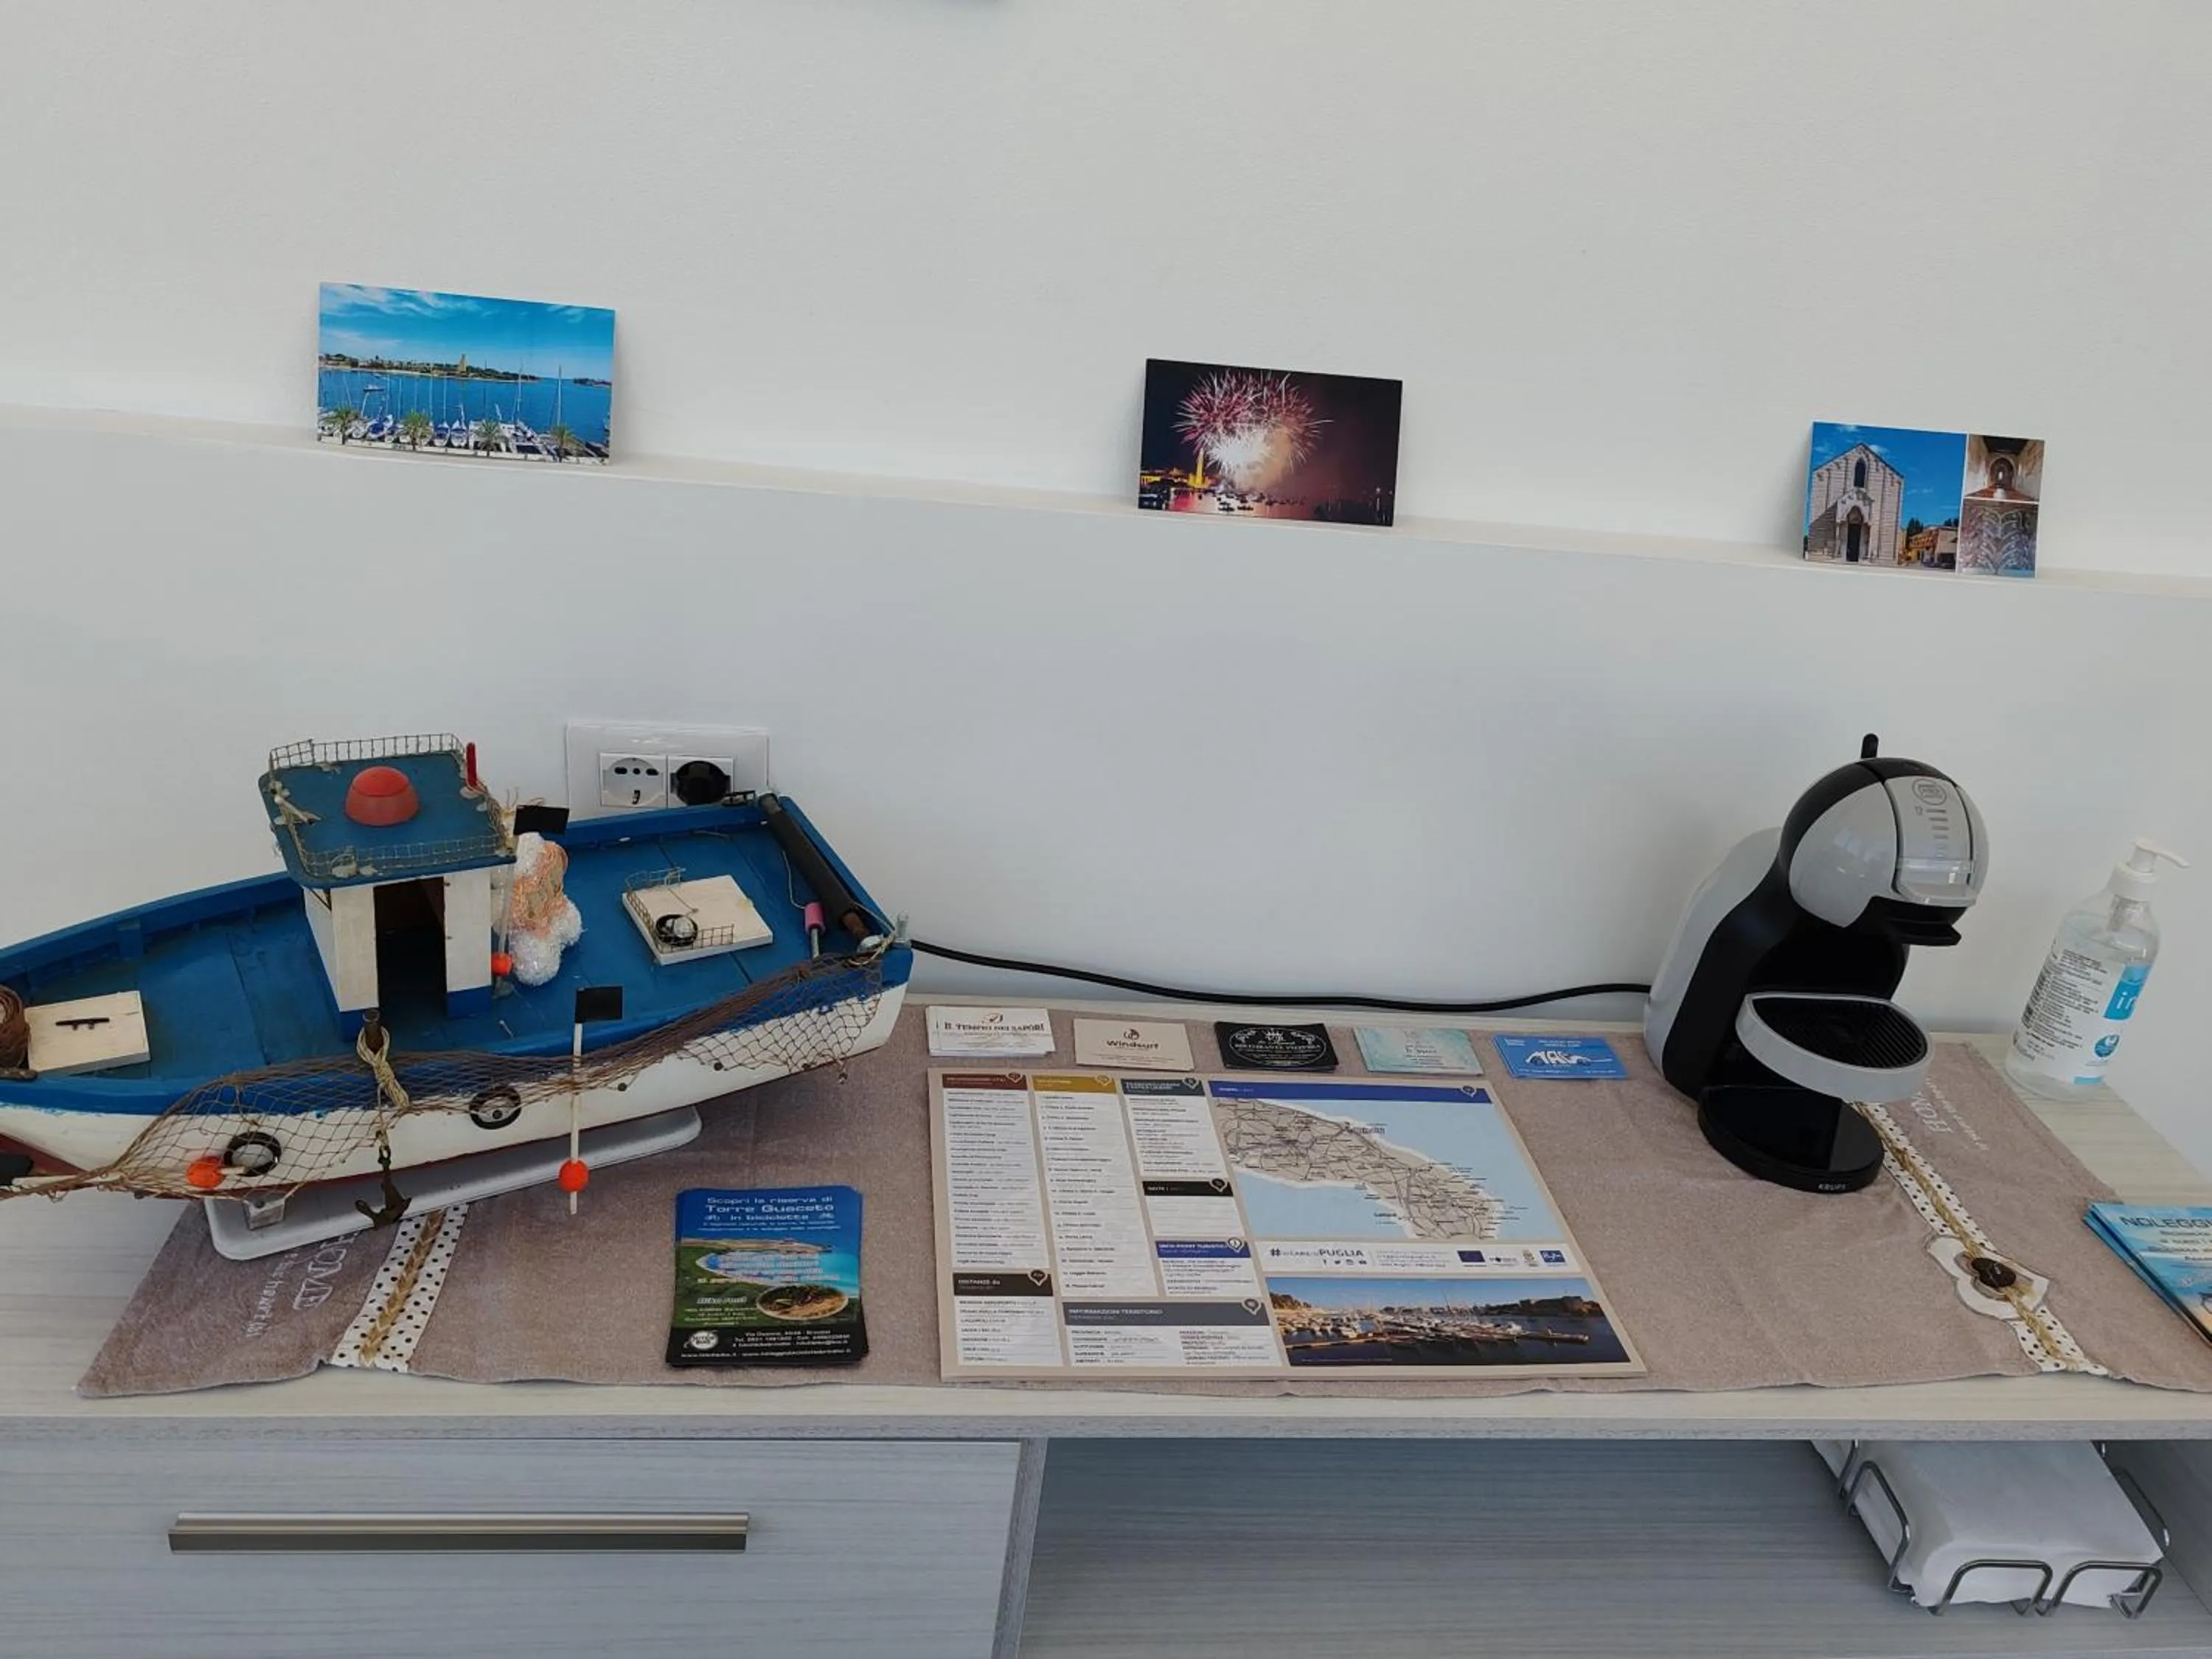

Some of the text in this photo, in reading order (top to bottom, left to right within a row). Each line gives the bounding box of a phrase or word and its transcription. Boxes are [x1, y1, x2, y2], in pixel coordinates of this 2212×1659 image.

[707, 1197, 750, 1205] Scopri
[705, 1203, 835, 1213] Torre Guaceto
